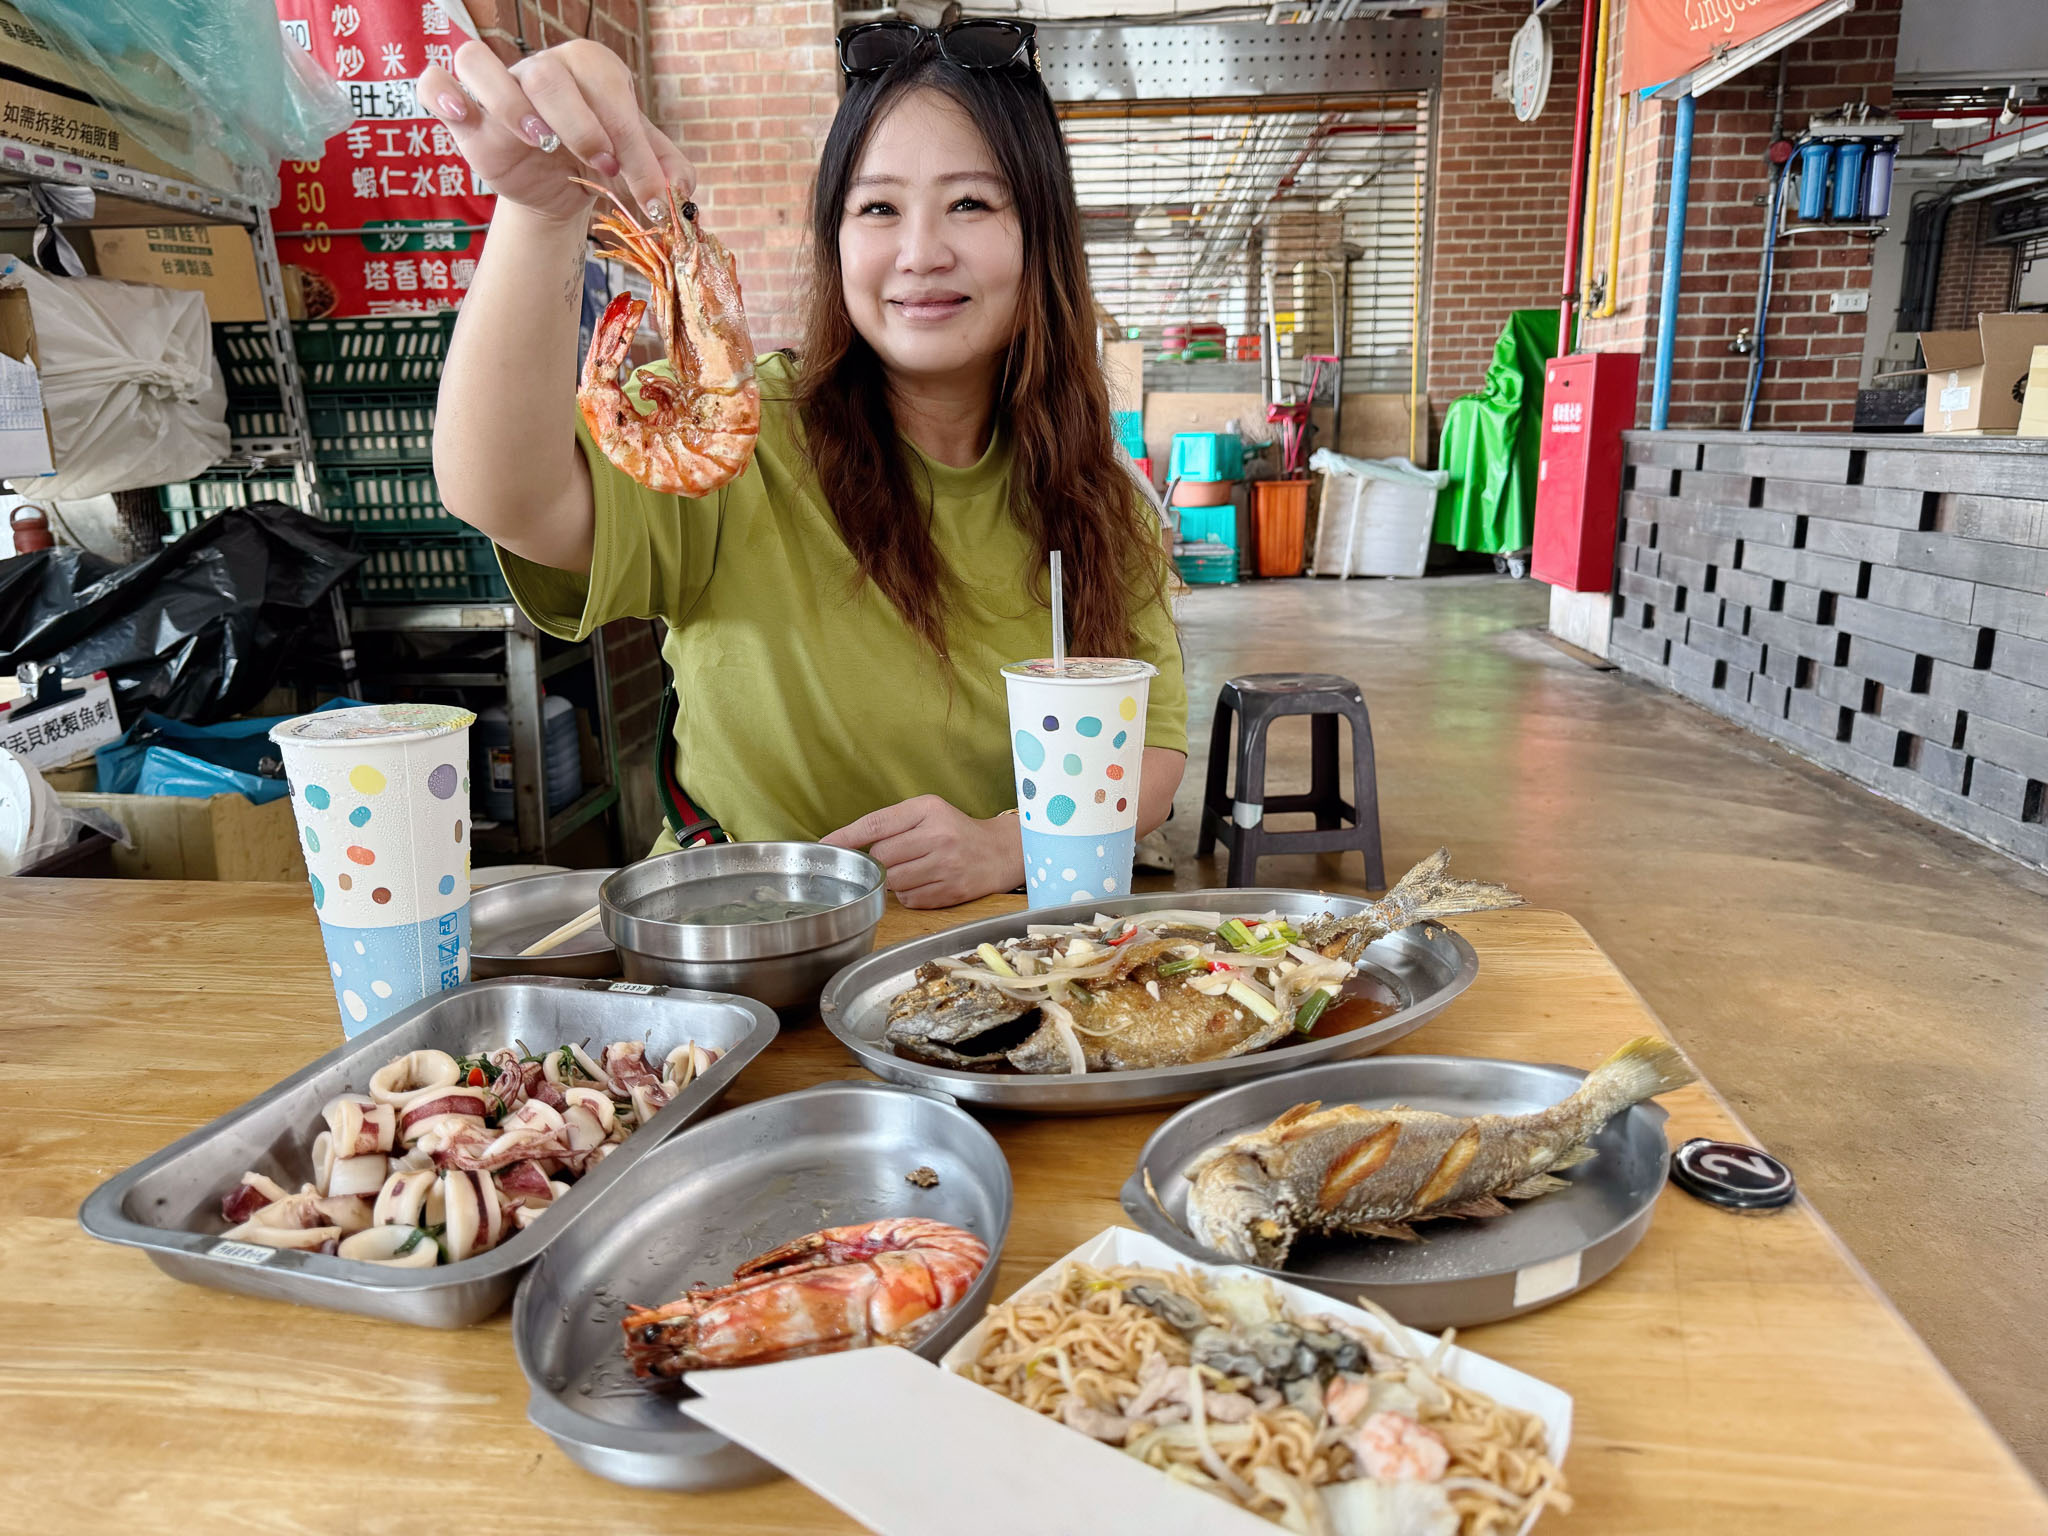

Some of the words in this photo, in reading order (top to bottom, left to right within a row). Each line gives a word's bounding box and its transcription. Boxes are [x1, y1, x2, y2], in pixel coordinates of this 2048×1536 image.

[331, 2, 451, 37] 炒麵
[336, 43, 454, 78] 炒米粉
[350, 82, 414, 118] 肚粥
[2, 101, 121, 152] 如需拆裝分箱販售
[346, 124, 462, 160] 手工水餃
[297, 181, 325, 214] 50
[351, 164, 467, 199] 蝦仁水餃
[302, 222, 331, 253] 50
